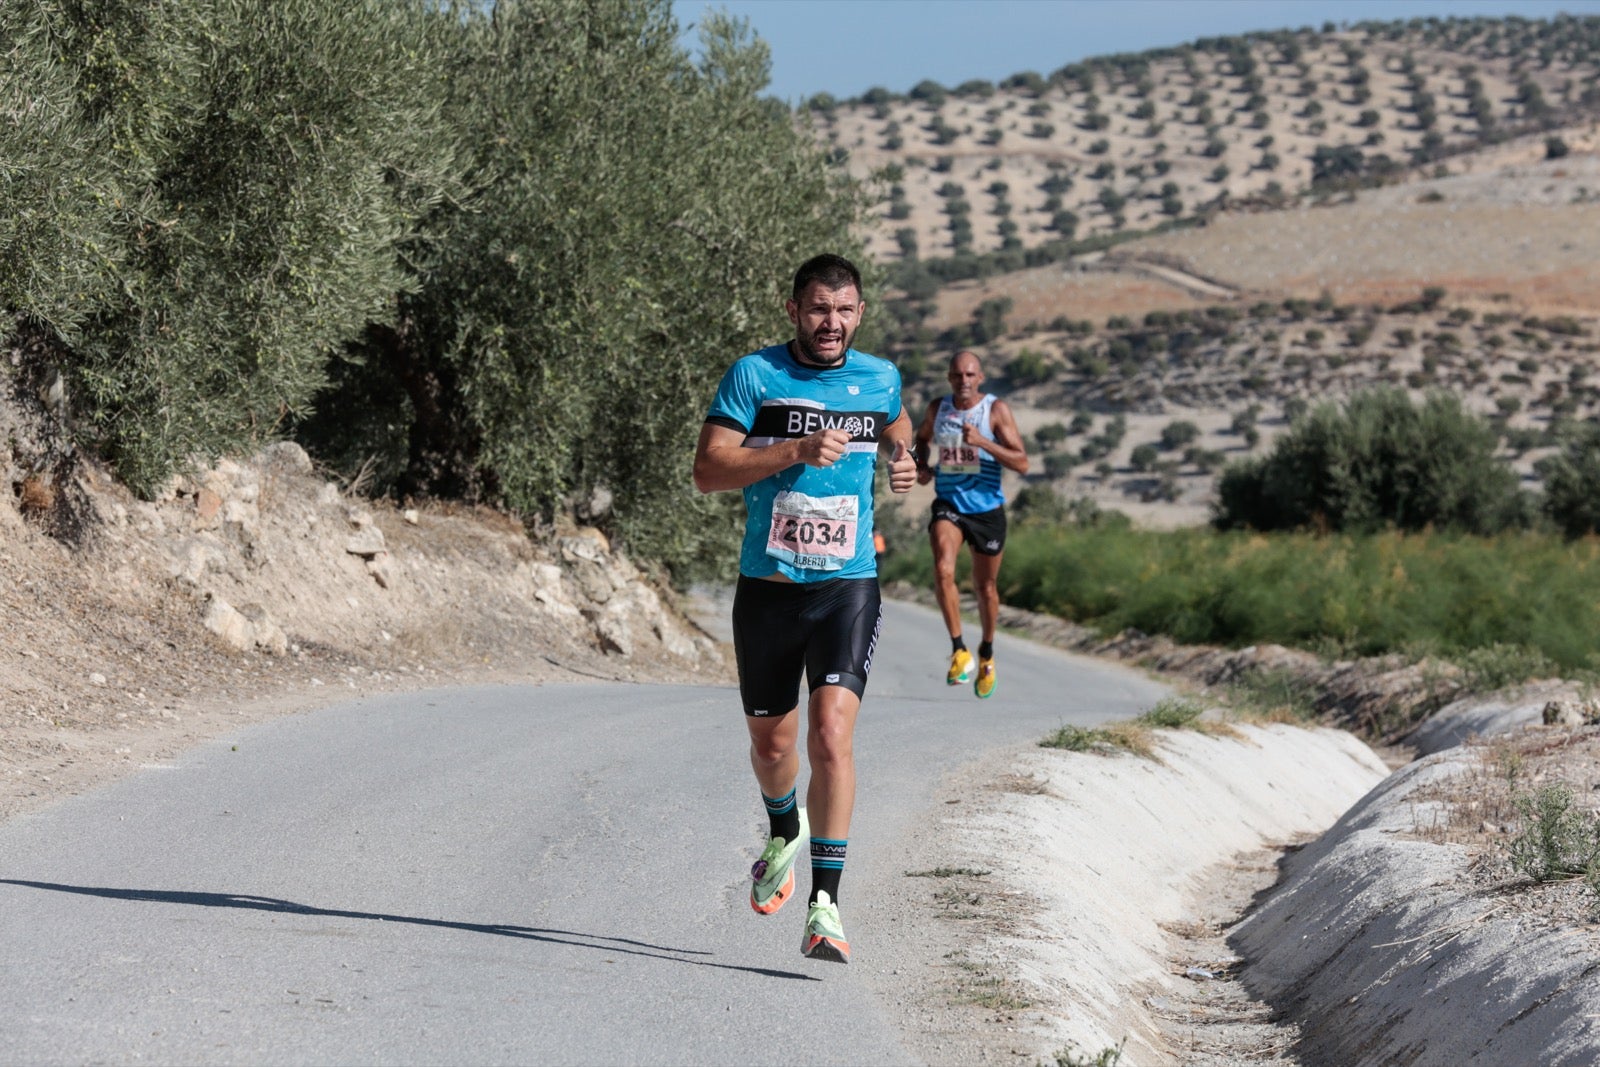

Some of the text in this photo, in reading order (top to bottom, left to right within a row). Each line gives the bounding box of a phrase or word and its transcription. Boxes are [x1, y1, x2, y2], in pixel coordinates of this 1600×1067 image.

[787, 410, 876, 438] BEWOR
[783, 519, 847, 547] 2034
[793, 554, 827, 567] ALBERTO
